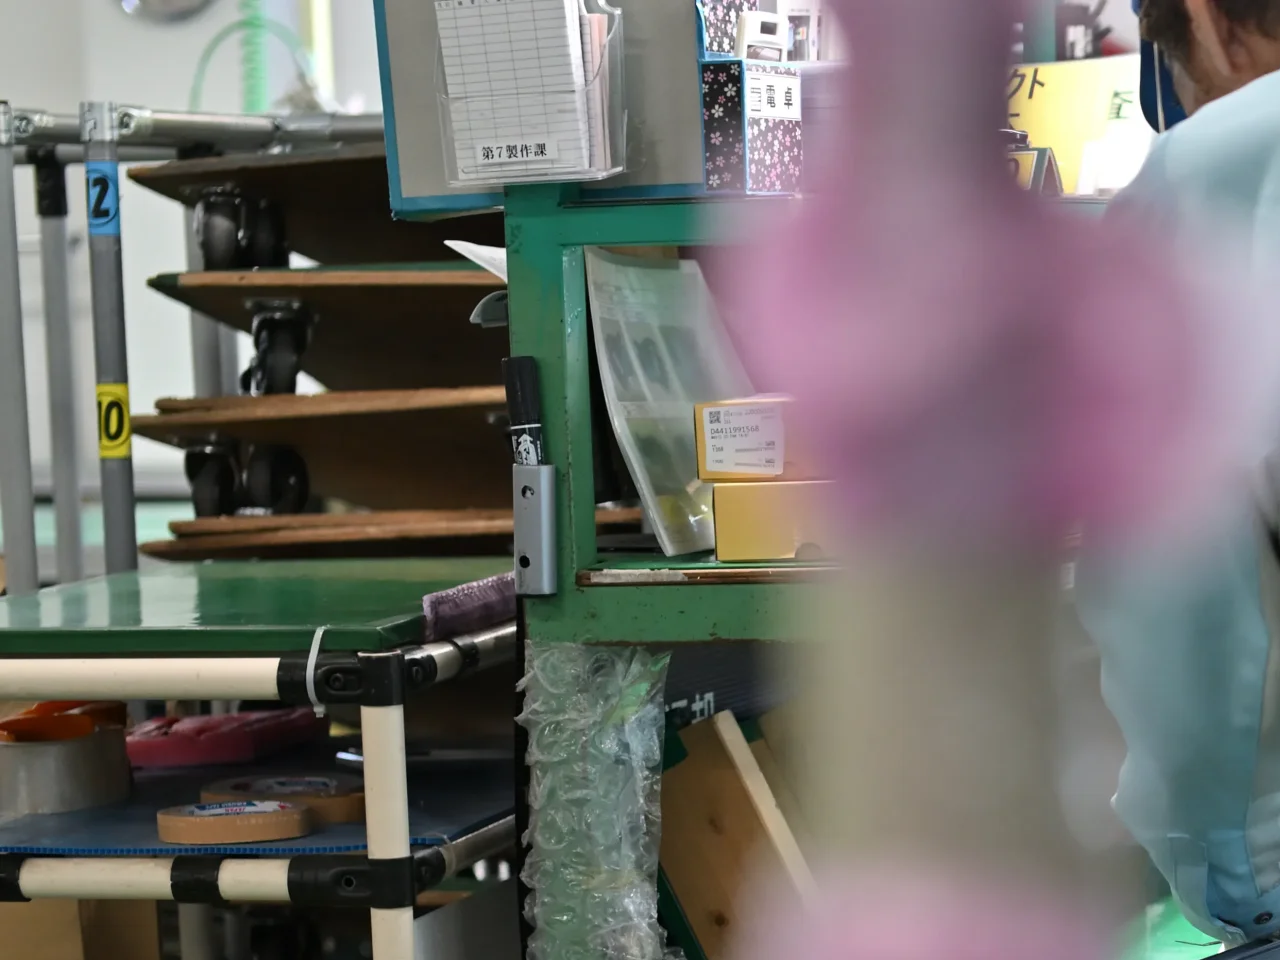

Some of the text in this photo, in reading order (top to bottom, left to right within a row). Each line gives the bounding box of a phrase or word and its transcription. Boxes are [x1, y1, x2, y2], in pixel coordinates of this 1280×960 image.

[482, 143, 547, 160] 第7製作課
[710, 425, 760, 435] D4411991568
